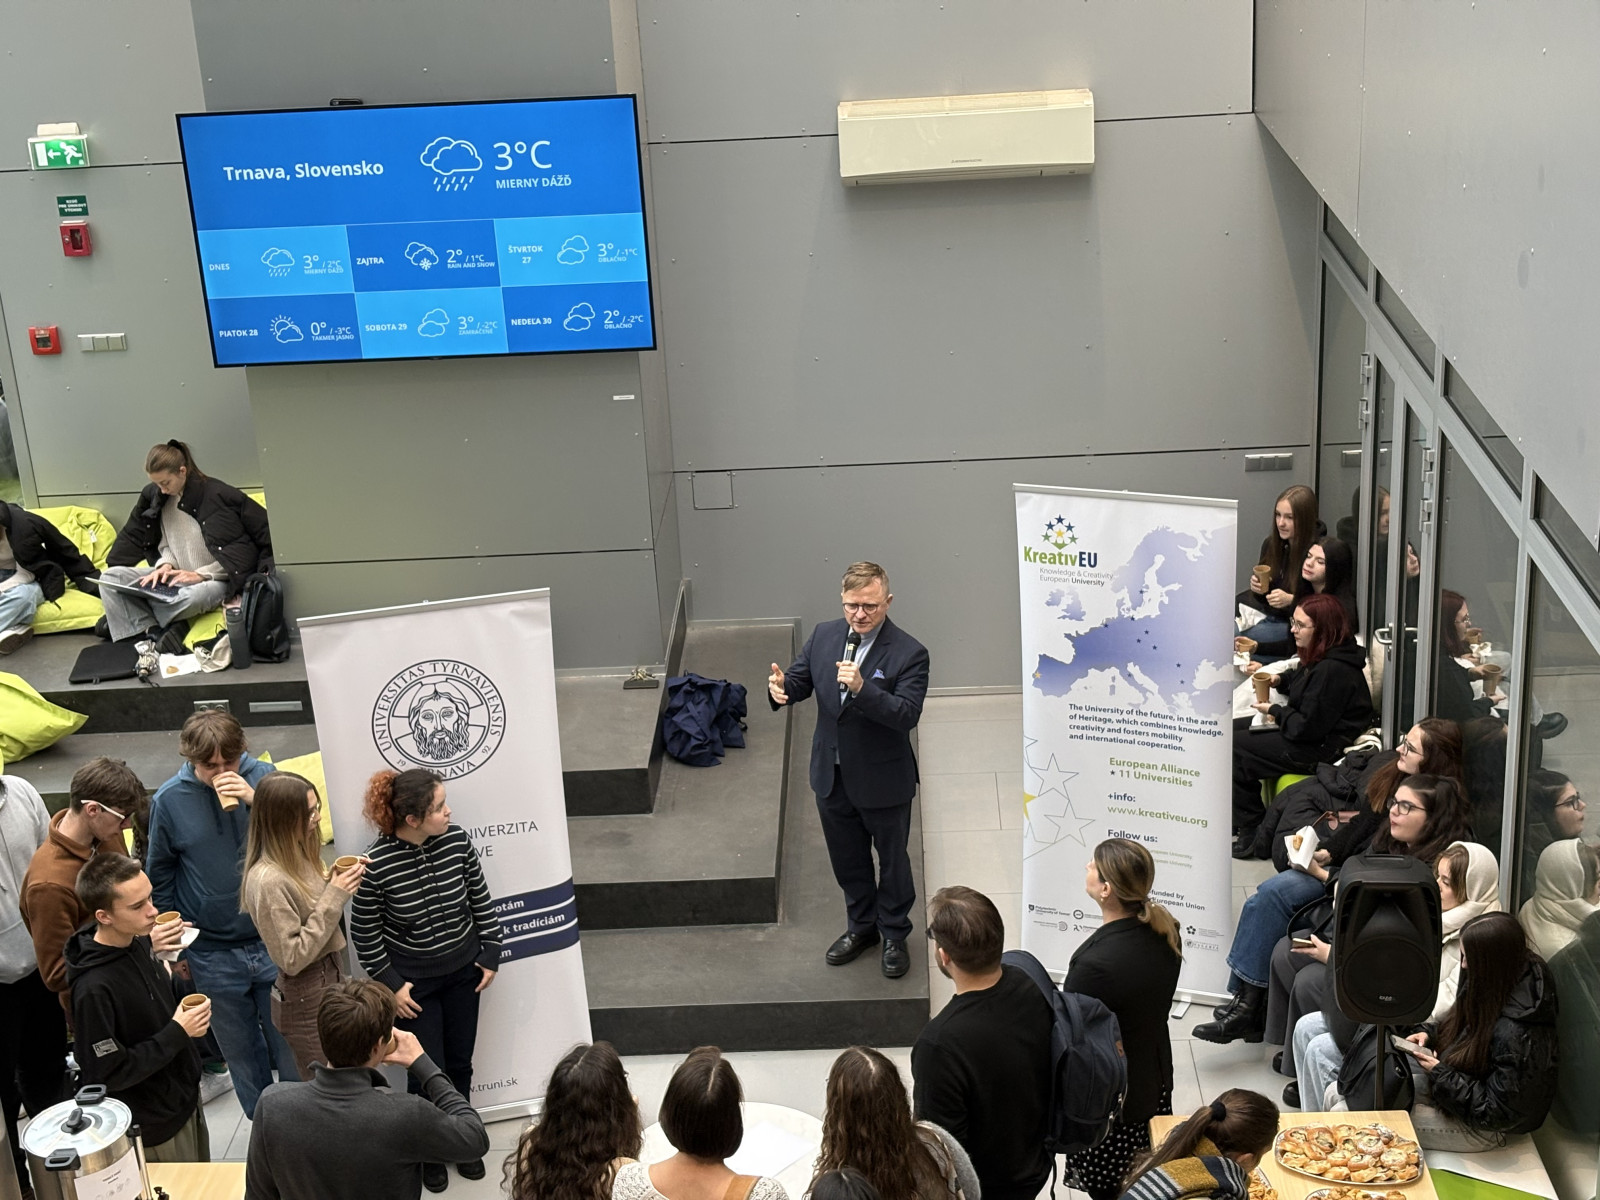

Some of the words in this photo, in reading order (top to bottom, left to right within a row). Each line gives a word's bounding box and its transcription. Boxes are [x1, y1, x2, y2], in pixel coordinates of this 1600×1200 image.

[493, 139, 553, 171] 3°C
[223, 164, 291, 182] Trnava,
[294, 159, 384, 179] Slovensko
[496, 177, 538, 189] MIERNY
[541, 174, 572, 187] DÁŽĎ
[507, 244, 543, 254] ŠTVRTOK
[209, 263, 230, 271] DNES
[356, 257, 384, 266] ZAJTRA
[365, 324, 396, 332] SOBOTA
[398, 323, 407, 331] 29
[511, 317, 541, 326] NEDEĽA
[542, 317, 552, 325] 30
[219, 330, 248, 338] PIATOK
[1040, 568, 1075, 577] Knowledge
[1083, 571, 1113, 580] Creativity
[1040, 575, 1070, 583] European
[1071, 577, 1105, 587] University
[375, 664, 425, 752] UNIVERSITAS
[429, 662, 503, 737] TYRNAVIENSIS
[1085, 705, 1124, 715] University
[1135, 709, 1148, 717] the
[1150, 711, 1175, 721] future,
[1079, 714, 1114, 724] Heritage,
[1116, 717, 1138, 725] which
[1140, 721, 1176, 731] combines
[1179, 725, 1224, 737] knowledge,
[1069, 724, 1105, 733] creativity
[1123, 728, 1149, 737] fosters
[1151, 732, 1183, 742] mobility
[482, 745, 491, 755] 92
[1086, 734, 1135, 745] international
[1137, 740, 1185, 752] cooperation.
[396, 758, 406, 767] 19
[1109, 757, 1158, 770] European
[1160, 763, 1200, 777] Alliance
[1119, 769, 1130, 779] 11
[1134, 771, 1193, 787] Universities
[1108, 792, 1136, 802] +info:
[1107, 806, 1208, 828] www.kreativeu.org
[466, 820, 539, 840] NIVERZITA
[1107, 829, 1140, 840] Follow
[1143, 834, 1158, 843] us:
[1176, 892, 1185, 900] by
[1186, 902, 1205, 911] Union
[503, 925, 510, 934] k
[513, 914, 565, 932] tradíciám
